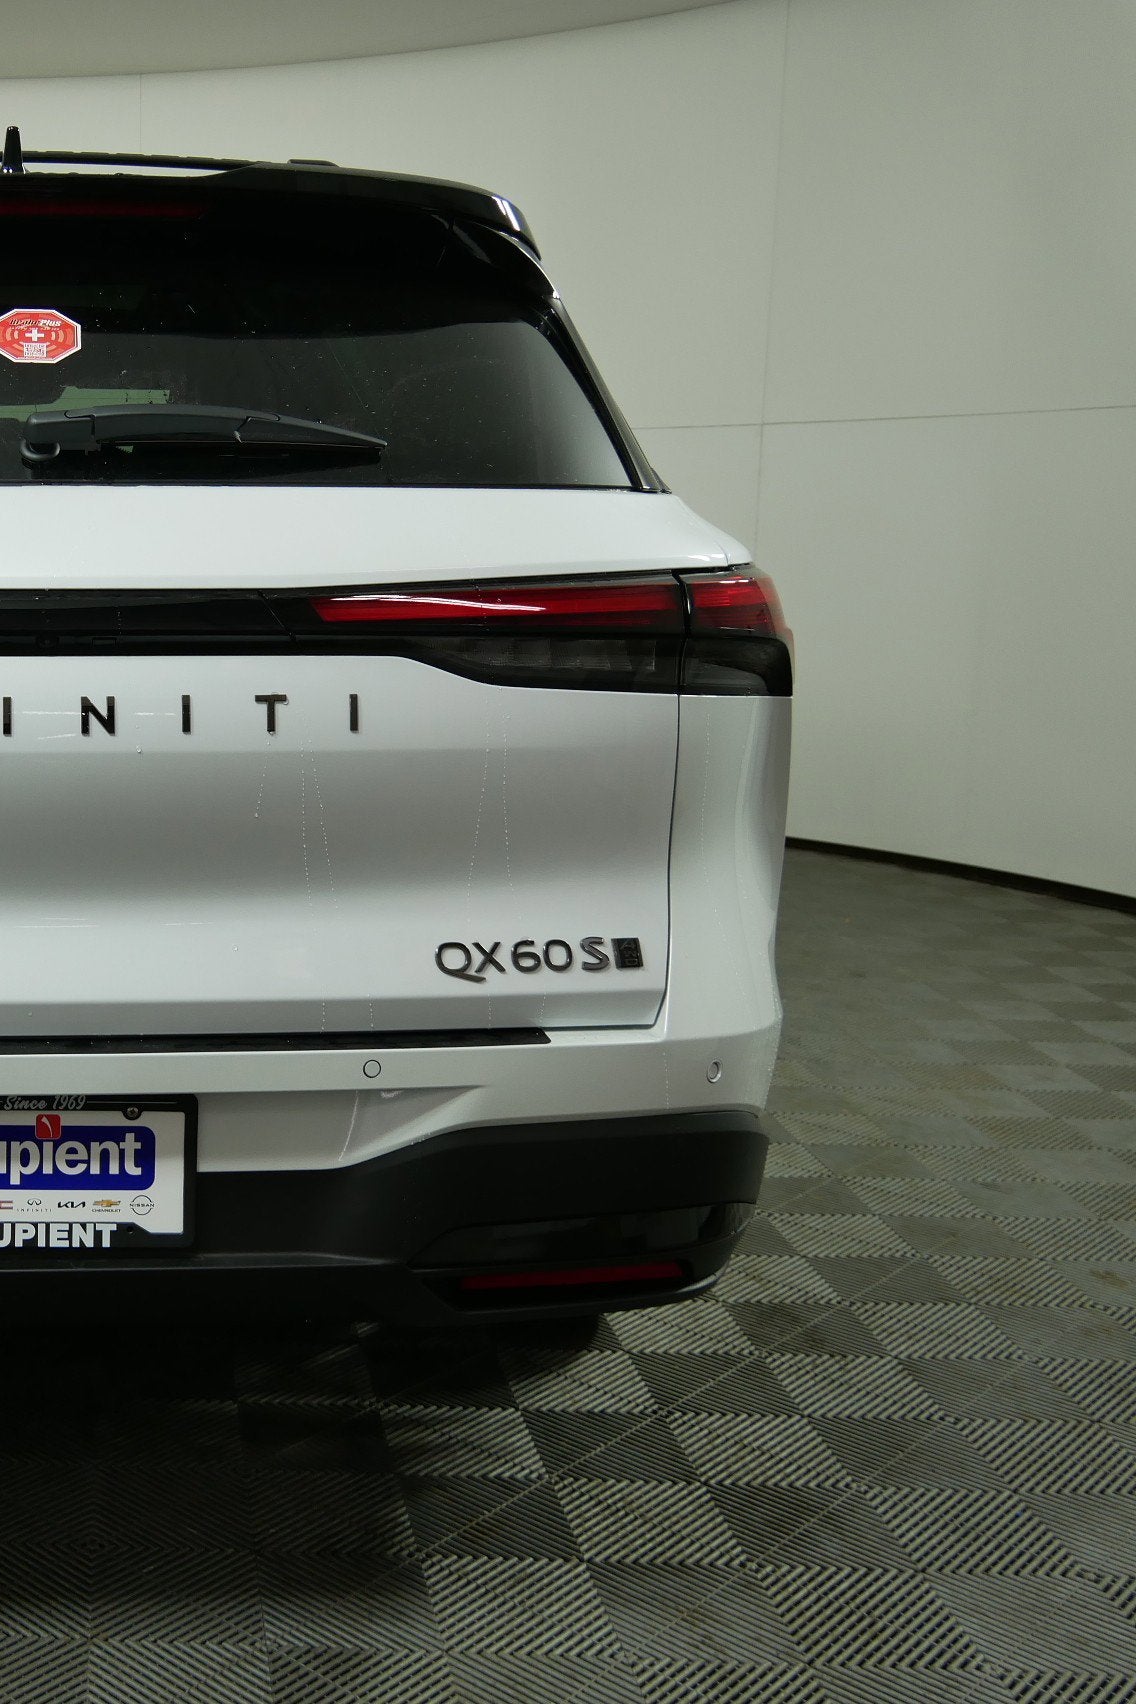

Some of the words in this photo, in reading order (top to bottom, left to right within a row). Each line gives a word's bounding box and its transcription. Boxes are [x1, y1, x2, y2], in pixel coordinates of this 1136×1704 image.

[4, 1096, 48, 1111] Since
[52, 1095, 87, 1111] 1969
[57, 1200, 86, 1209] KIA
